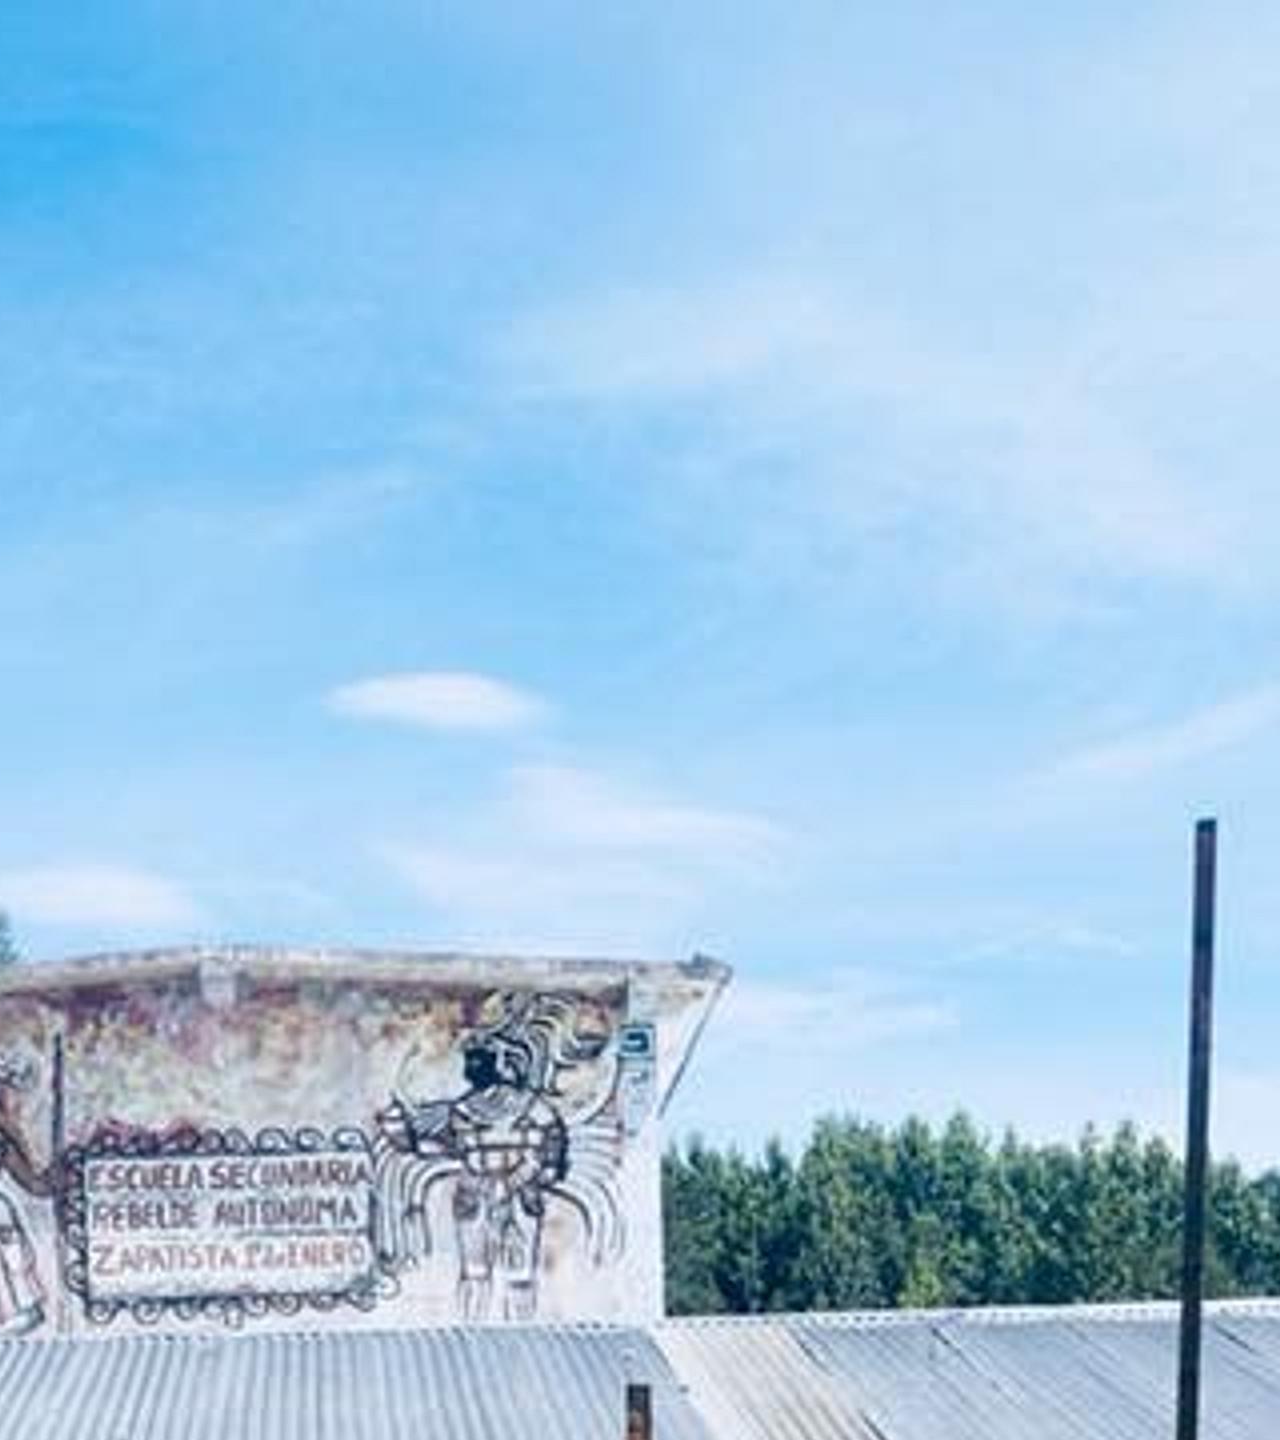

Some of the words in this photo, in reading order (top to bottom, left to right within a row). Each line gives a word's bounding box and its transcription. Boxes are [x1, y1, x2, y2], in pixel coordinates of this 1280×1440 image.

[88, 1161, 205, 1190] ESCUELA
[208, 1158, 370, 1189] SECUNDARIA
[91, 1200, 197, 1231] REBELDE
[92, 1242, 237, 1276] ZAPATISTA
[287, 1240, 366, 1268] ENERO
